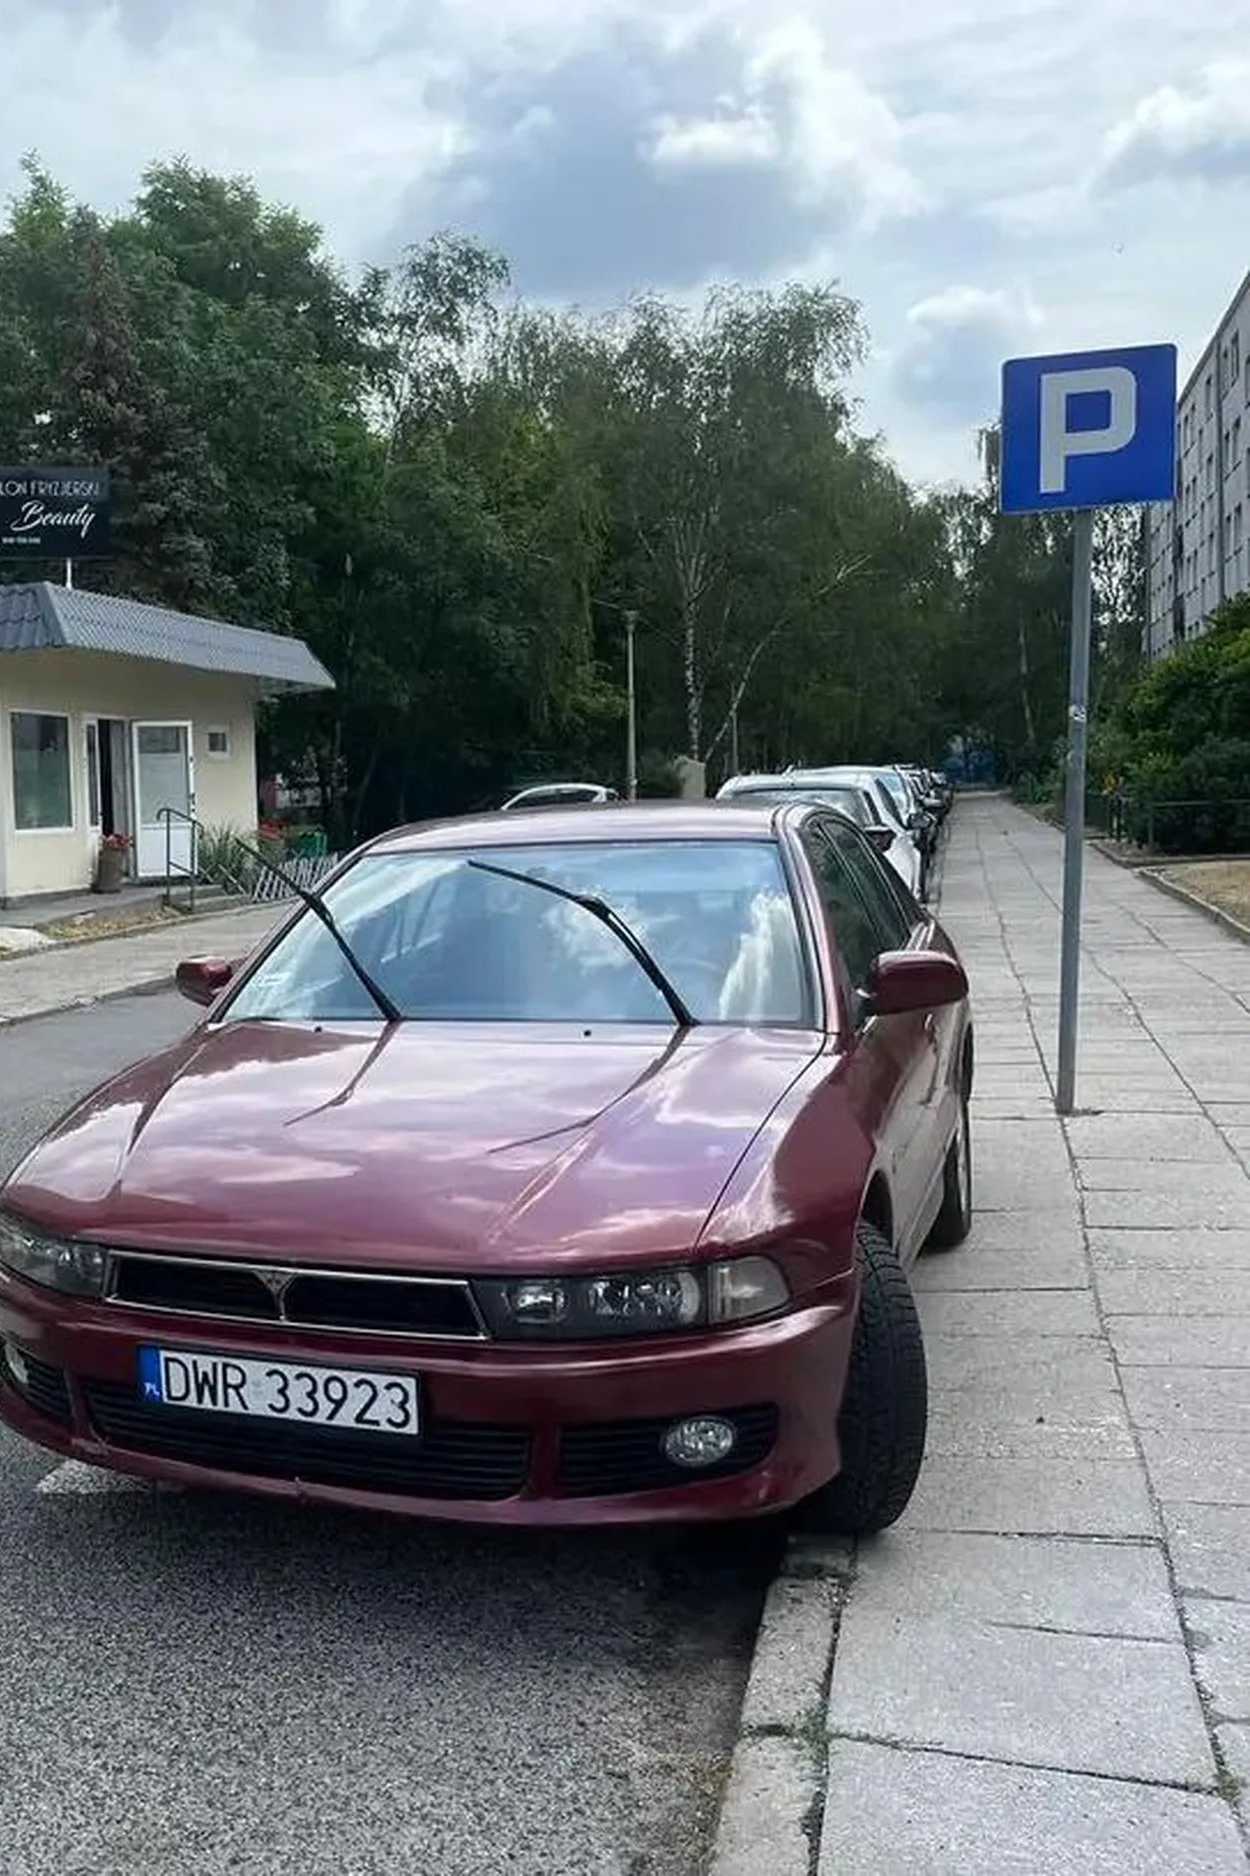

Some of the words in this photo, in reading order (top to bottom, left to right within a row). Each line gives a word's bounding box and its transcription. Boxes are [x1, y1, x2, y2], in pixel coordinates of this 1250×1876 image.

[1040, 366, 1137, 493] P
[10, 500, 96, 538] Beauty
[164, 1356, 249, 1410] DWR
[265, 1369, 410, 1429] 33923
